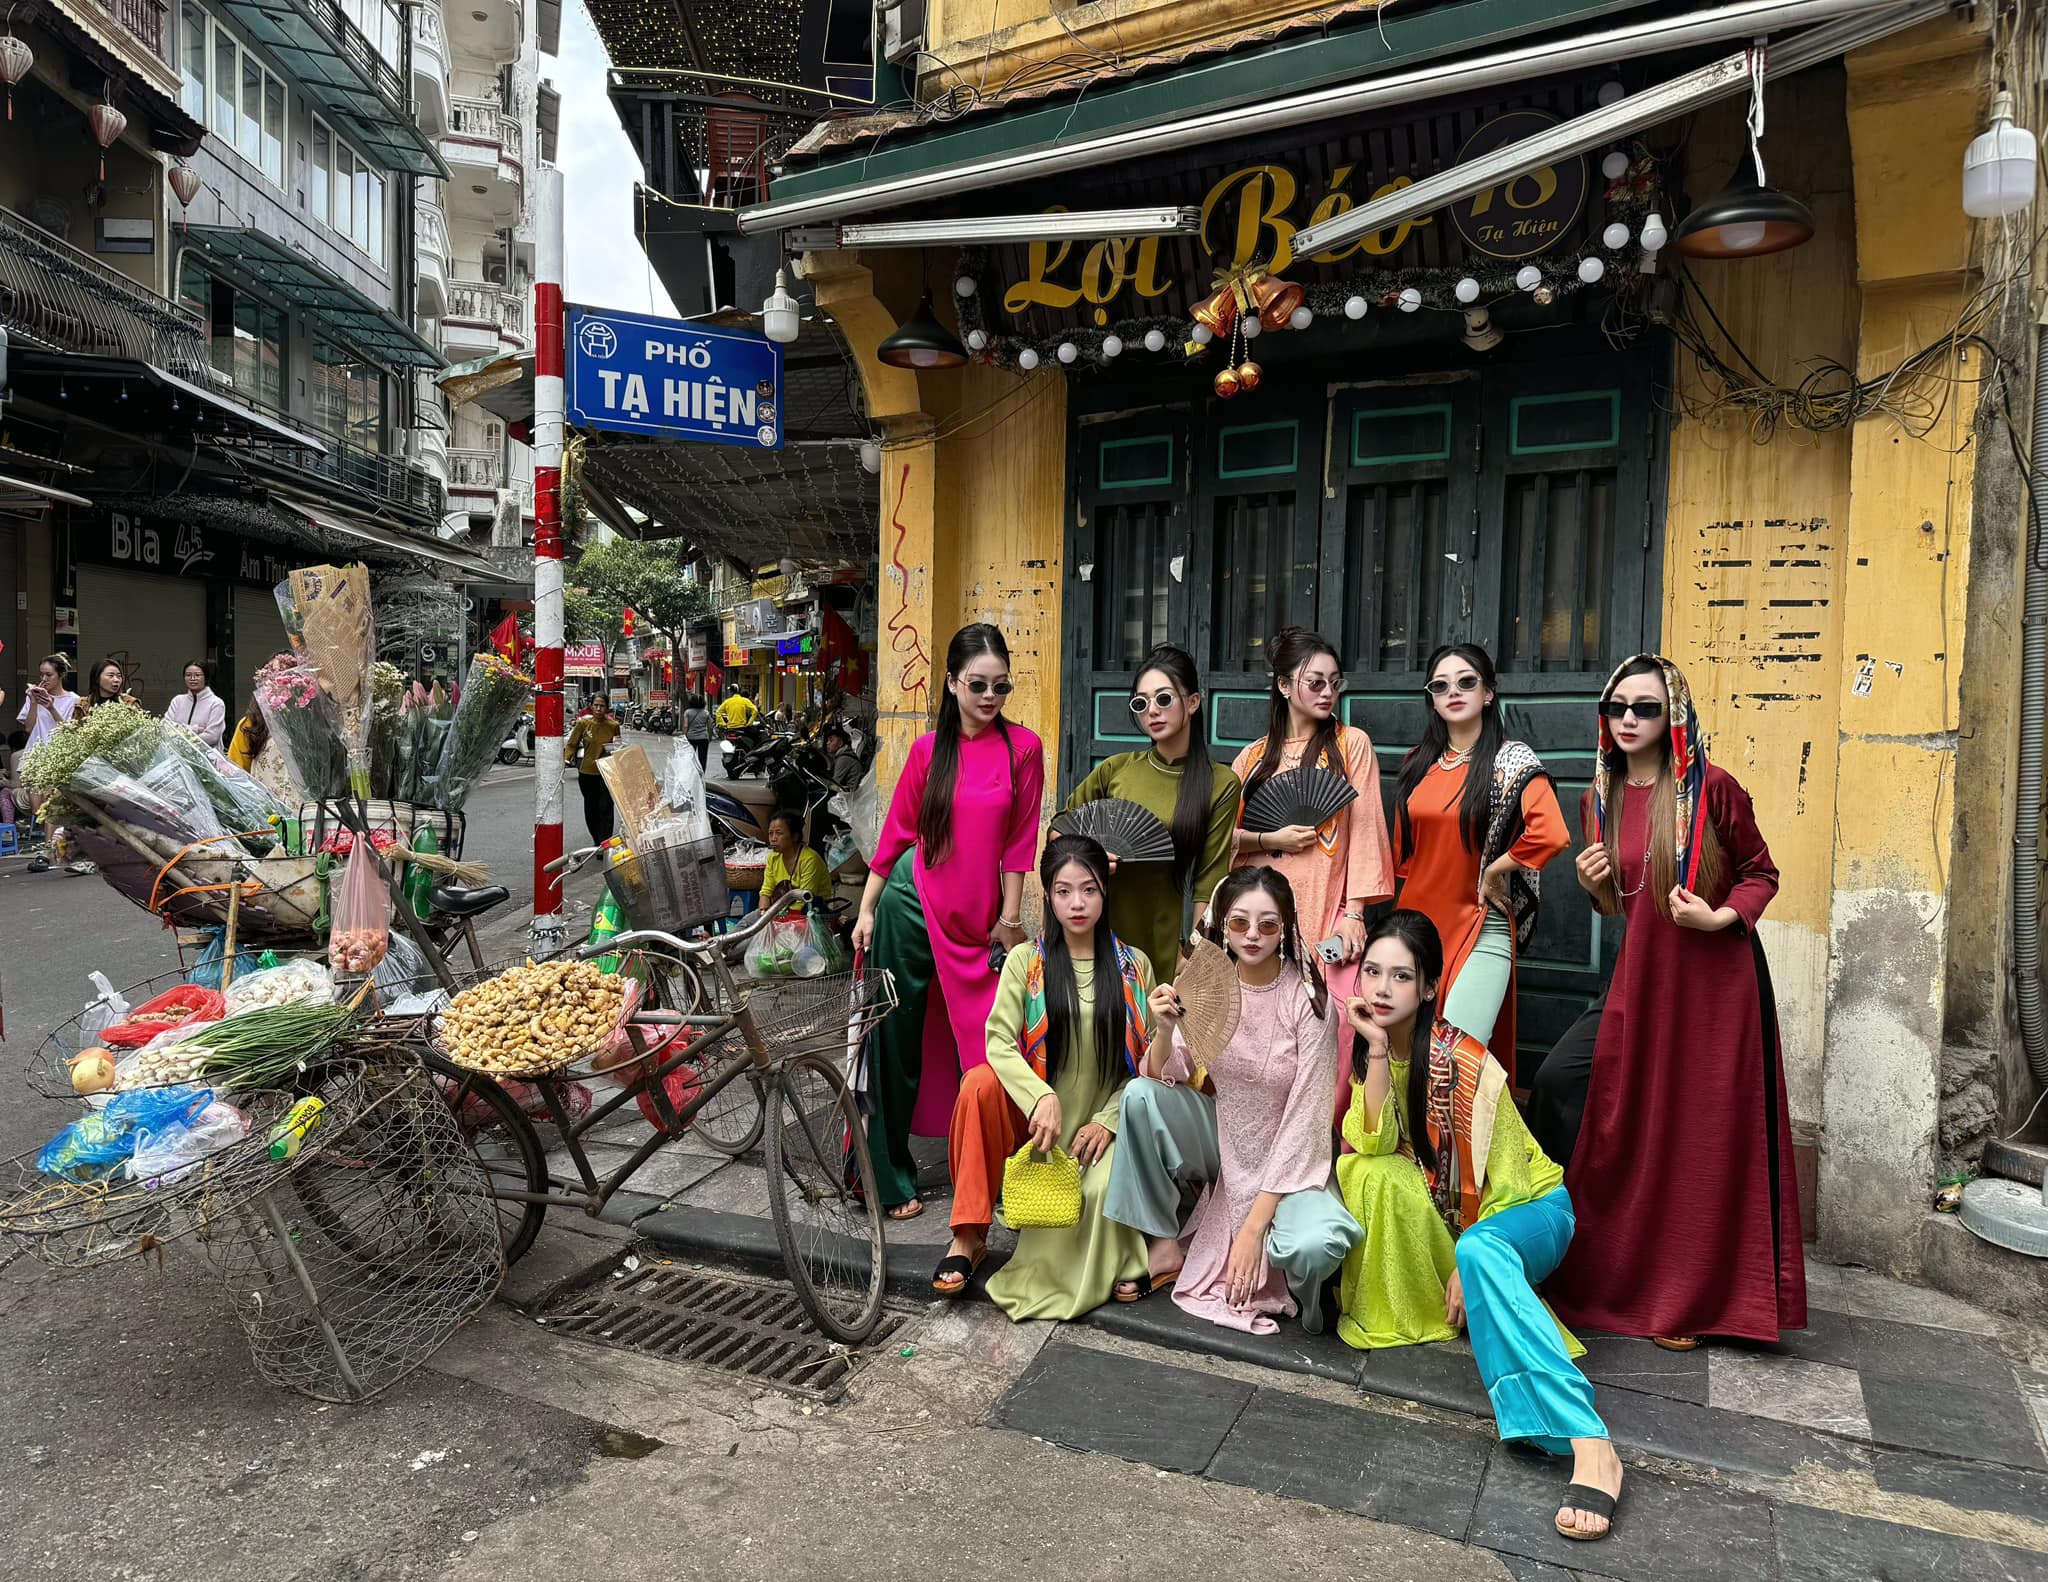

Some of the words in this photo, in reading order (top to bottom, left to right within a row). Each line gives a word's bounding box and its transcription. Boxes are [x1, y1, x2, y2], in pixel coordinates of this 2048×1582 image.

[1477, 225, 1504, 243] Tạ
[1511, 219, 1558, 237] Hiện
[645, 339, 712, 369] PHỐ
[598, 369, 650, 419] TẠ
[663, 375, 756, 430] HIỆN
[112, 512, 160, 565] Bia
